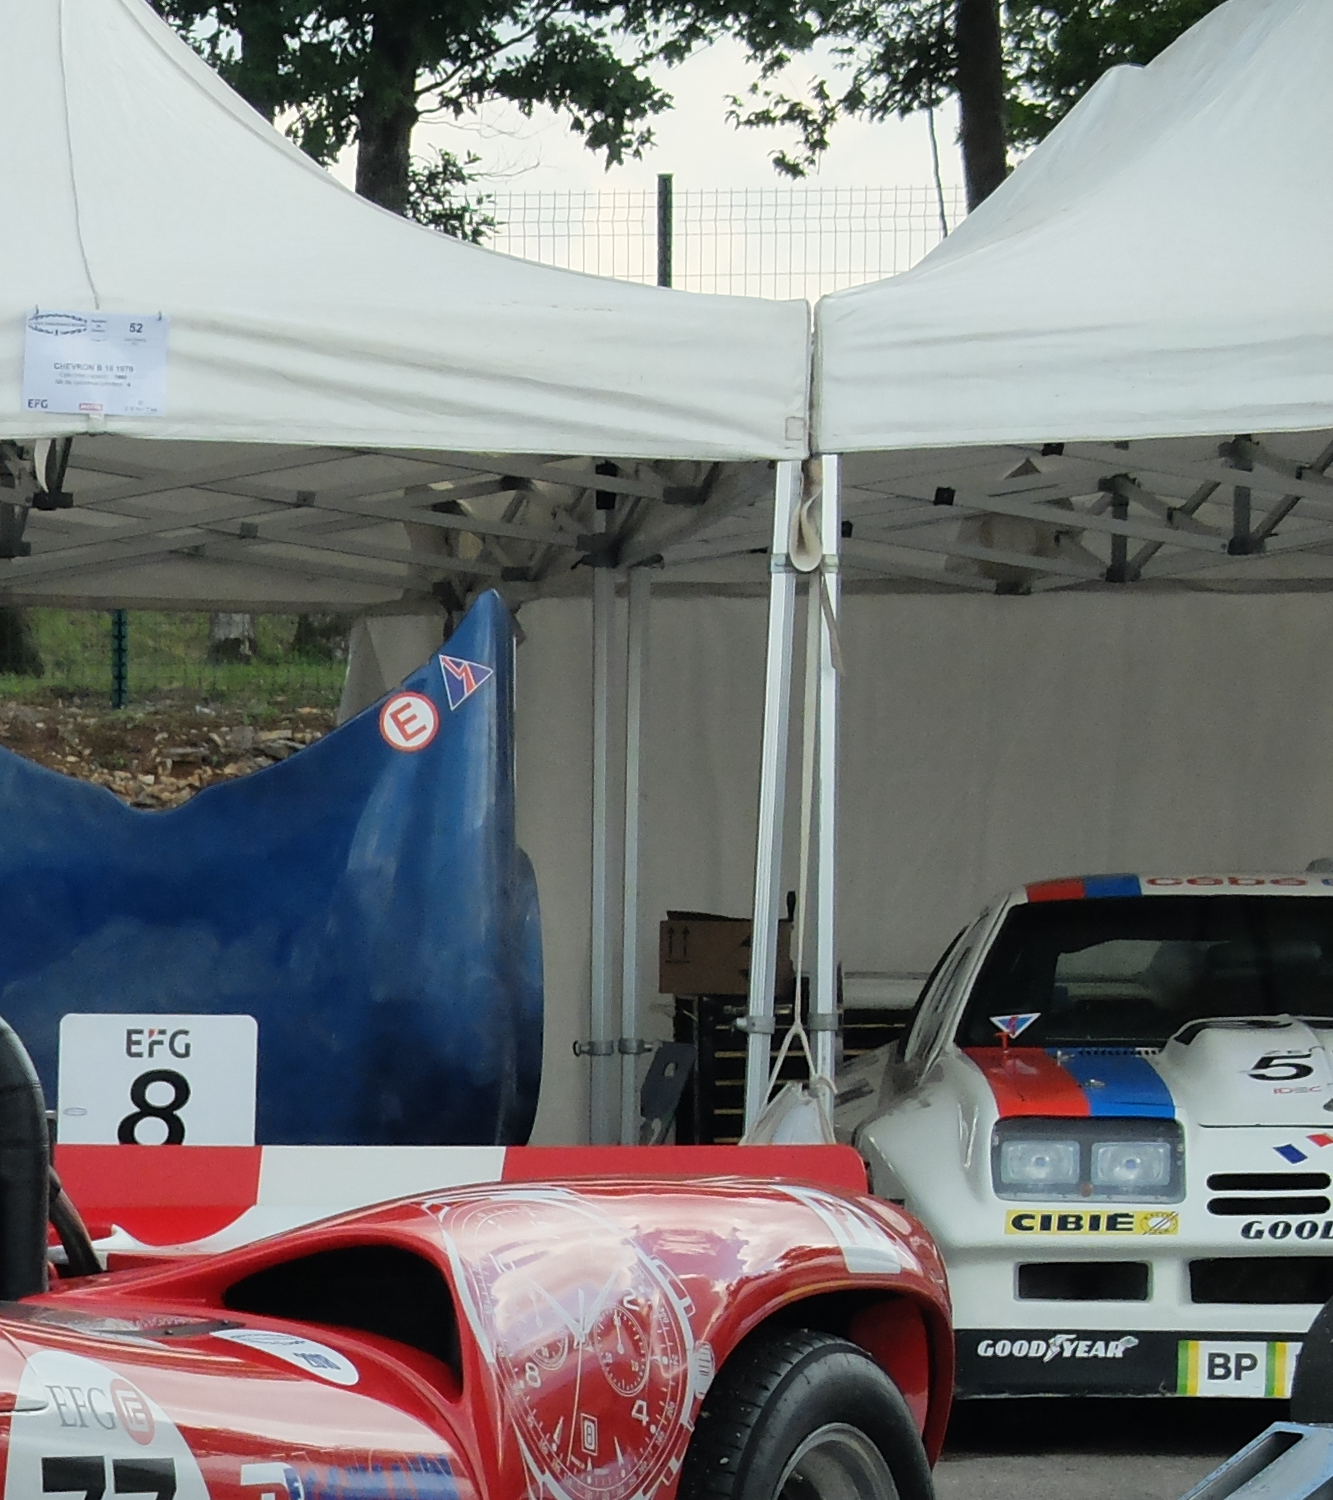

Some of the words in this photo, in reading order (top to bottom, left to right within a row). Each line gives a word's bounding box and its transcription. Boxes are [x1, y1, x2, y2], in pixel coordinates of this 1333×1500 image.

[129, 323, 144, 333] 52
[54, 363, 94, 371] CHEVRON
[28, 399, 48, 409] EFG
[390, 702, 427, 742] E
[126, 1028, 191, 1058] EFG
[1247, 1053, 1314, 1081] 5
[117, 1068, 191, 1146] 8
[977, 1336, 1129, 1360] GOODYEAR
[1207, 1352, 1258, 1381] BP
[45, 1384, 118, 1431] EFG
